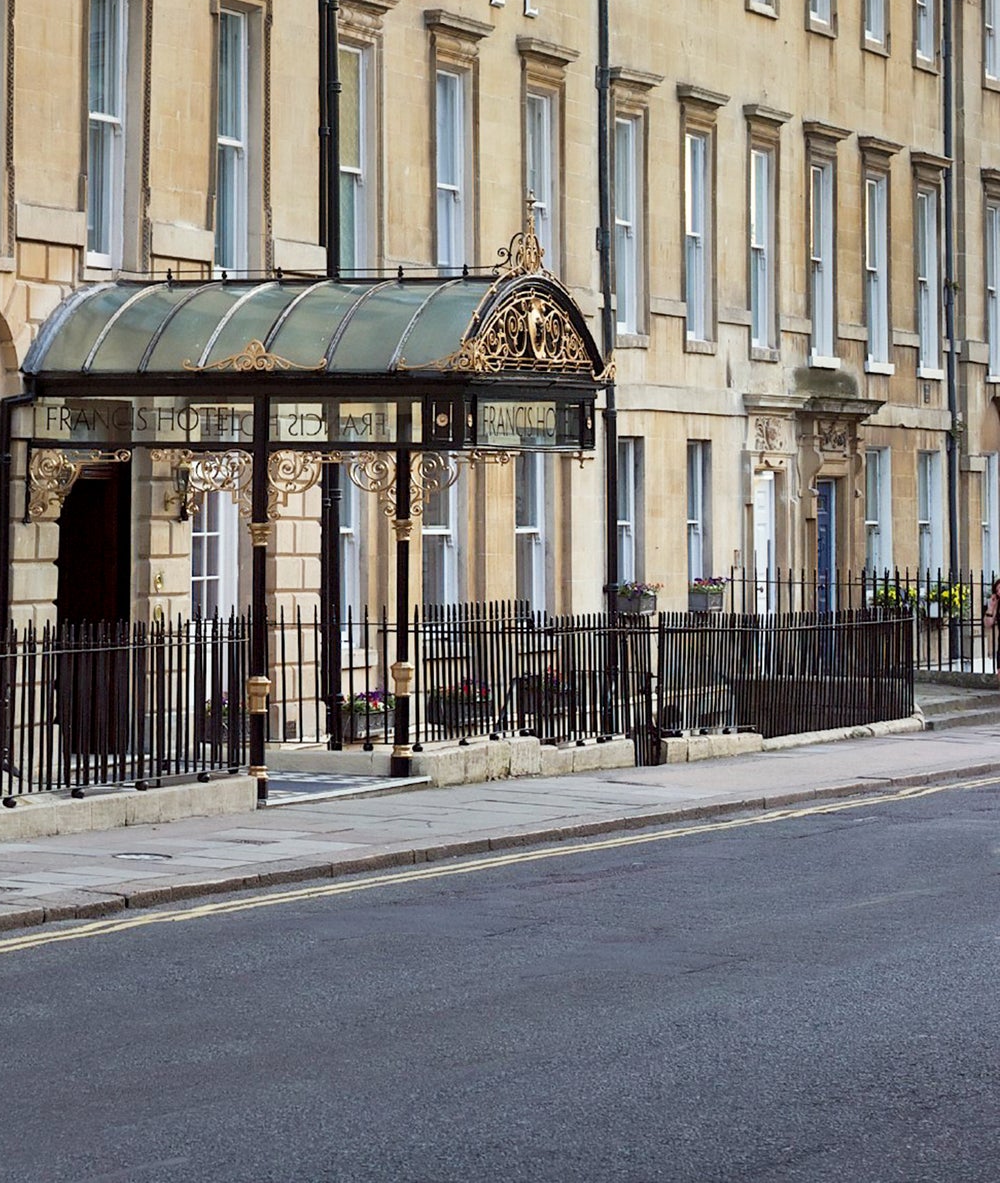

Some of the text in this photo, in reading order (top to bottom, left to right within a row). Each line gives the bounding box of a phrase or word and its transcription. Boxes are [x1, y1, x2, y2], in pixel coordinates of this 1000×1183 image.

[46, 406, 242, 432] FRANCIS HOTEL
[483, 405, 533, 438] FRANCIS
